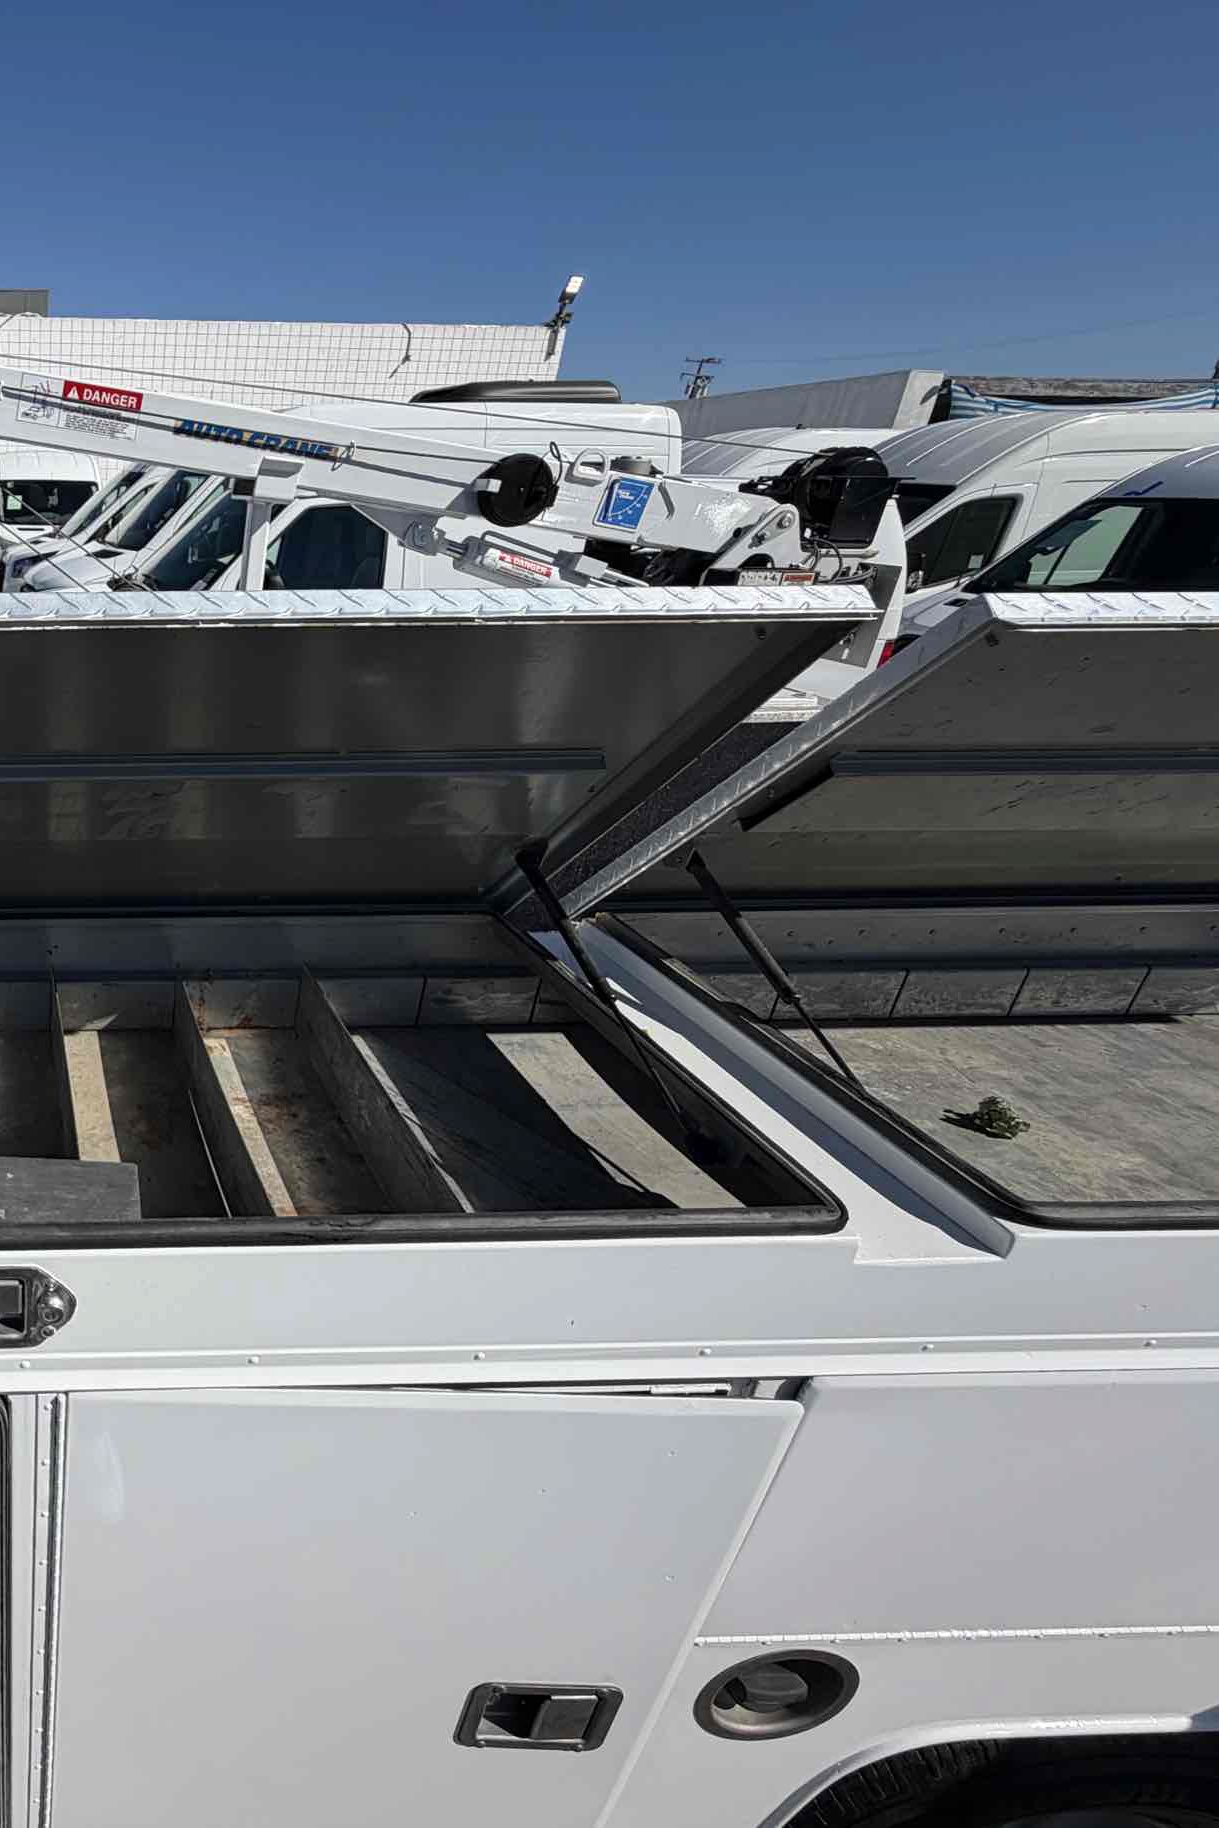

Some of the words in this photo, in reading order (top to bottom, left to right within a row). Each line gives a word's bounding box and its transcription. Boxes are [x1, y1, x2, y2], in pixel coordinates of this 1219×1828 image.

[82, 387, 139, 410] DANGER
[176, 419, 245, 446] AUTO
[247, 430, 335, 462] CRANE
[513, 556, 548, 575] DANGER
